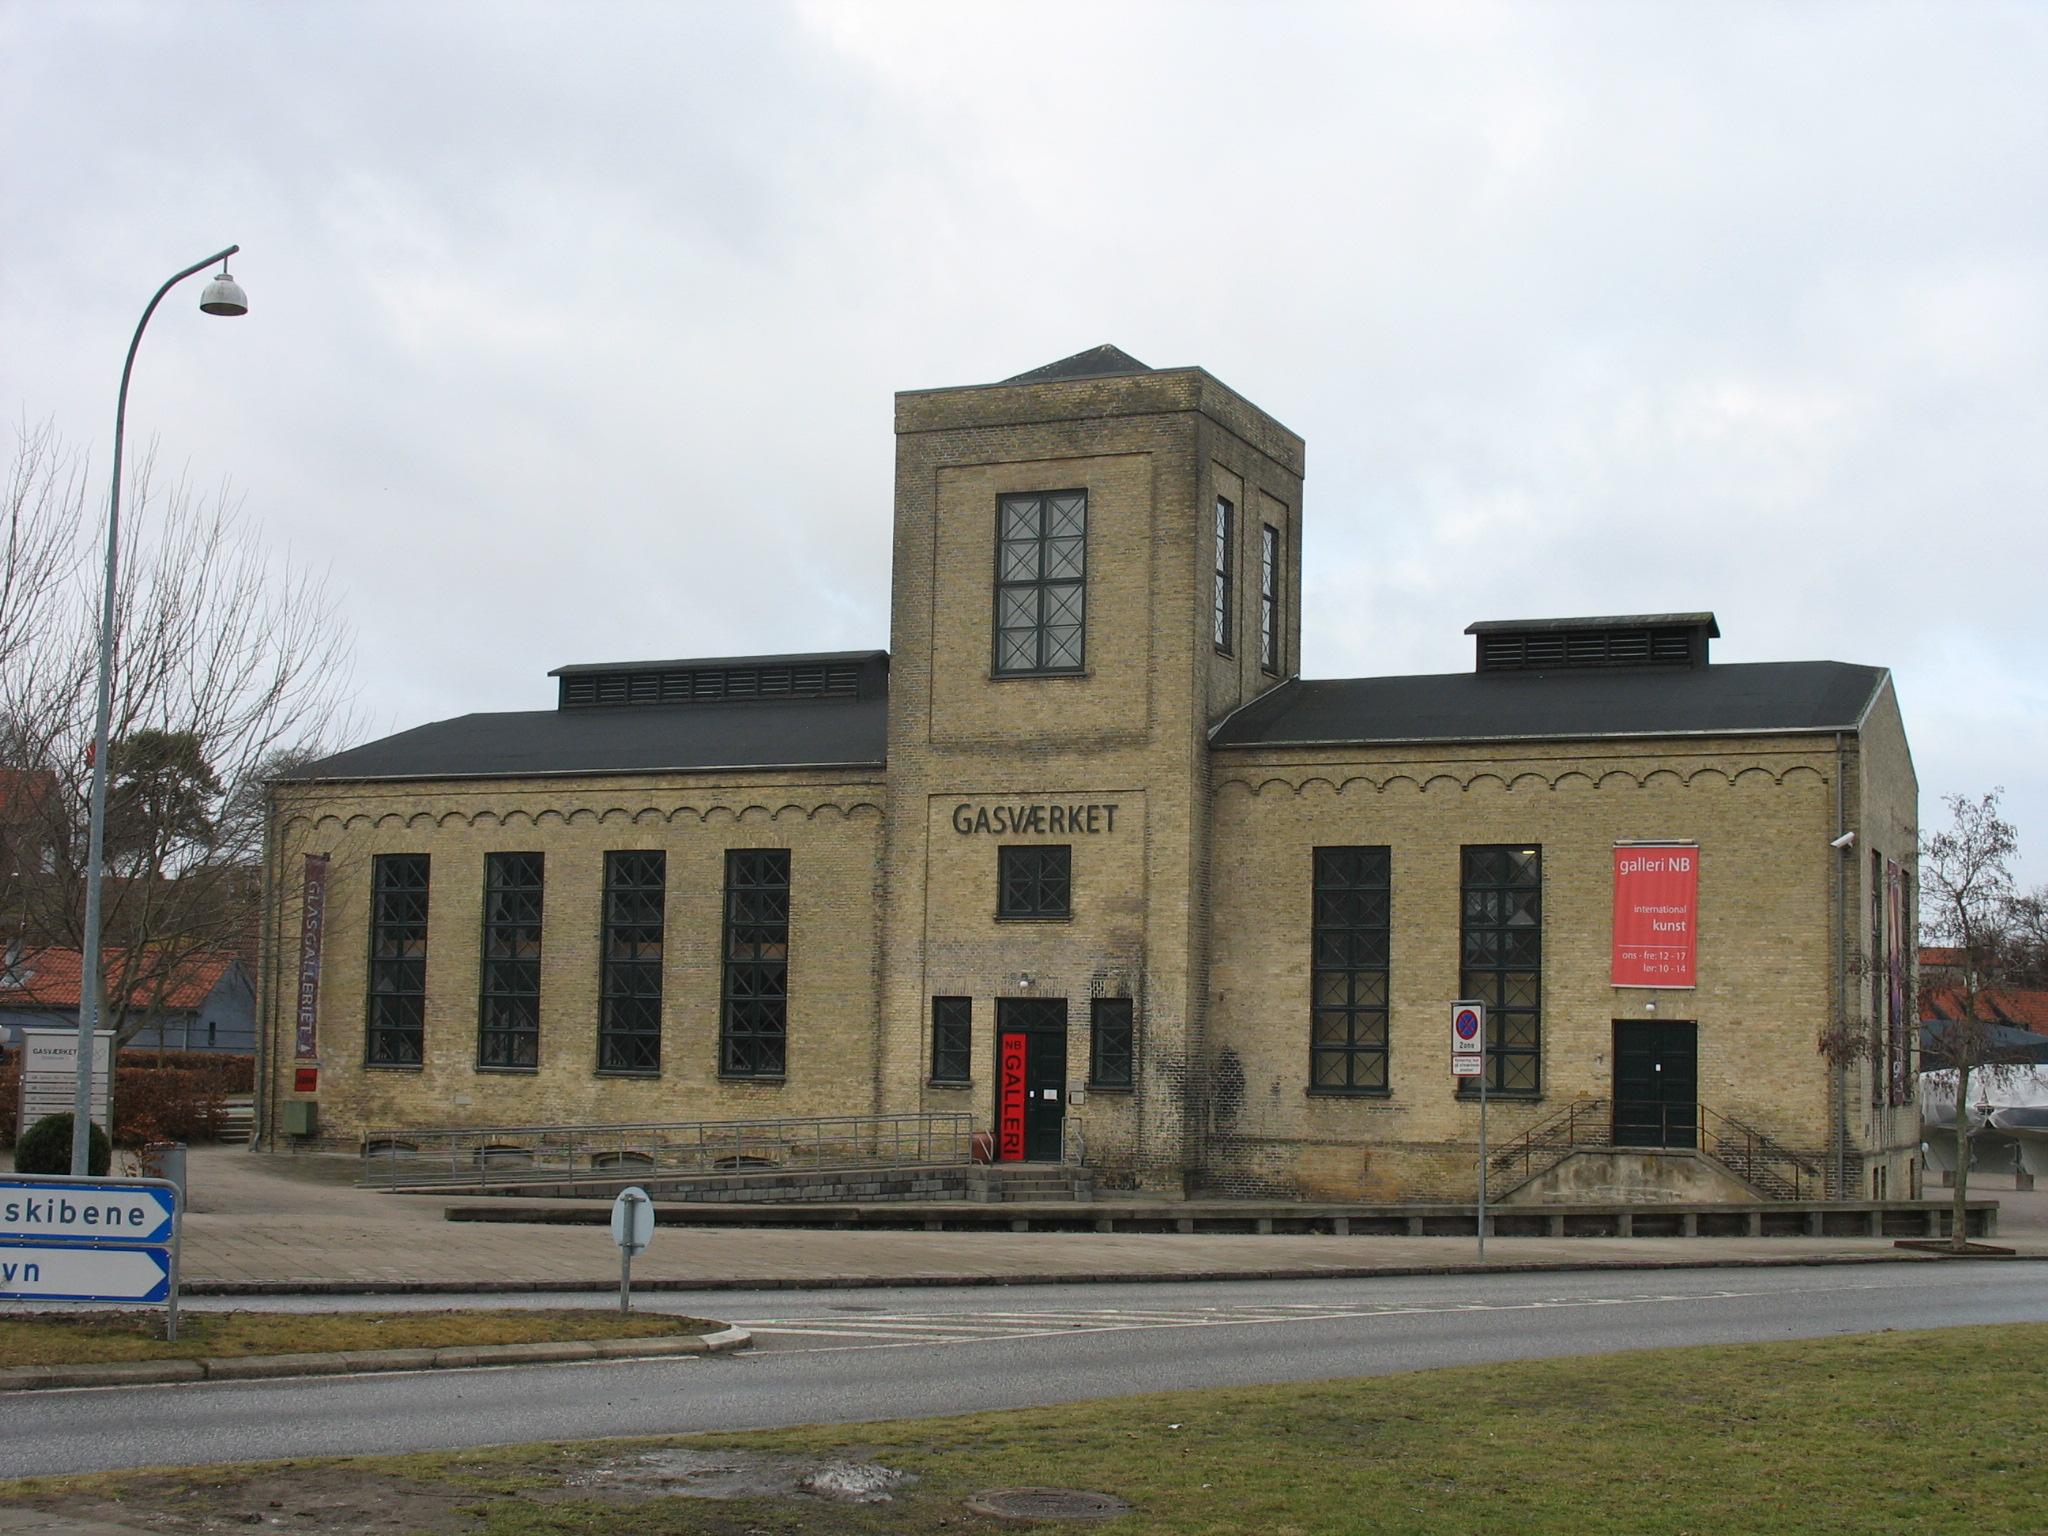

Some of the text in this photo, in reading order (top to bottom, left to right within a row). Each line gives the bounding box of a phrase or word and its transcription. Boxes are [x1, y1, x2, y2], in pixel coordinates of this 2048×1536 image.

[952, 803, 1119, 835] GASVÆRKET
[1619, 857, 1691, 875] galleri NB
[1634, 904, 1687, 914] international
[1652, 919, 1687, 932] kunst
[300, 880, 321, 1035] GLASGALLERIET
[1622, 952, 1637, 960] ons
[1643, 951, 1657, 960] fre:
[1659, 951, 1669, 960] 12
[1676, 952, 1686, 960] 17
[1643, 963, 1657, 972] lør:
[1659, 963, 1669, 972] 10
[1676, 963, 1686, 973] 14
[1005, 1040, 1022, 1049] NB
[33, 1048, 77, 1056] GASVÆRKET
[1003, 1055, 1021, 1154] GALLERI
